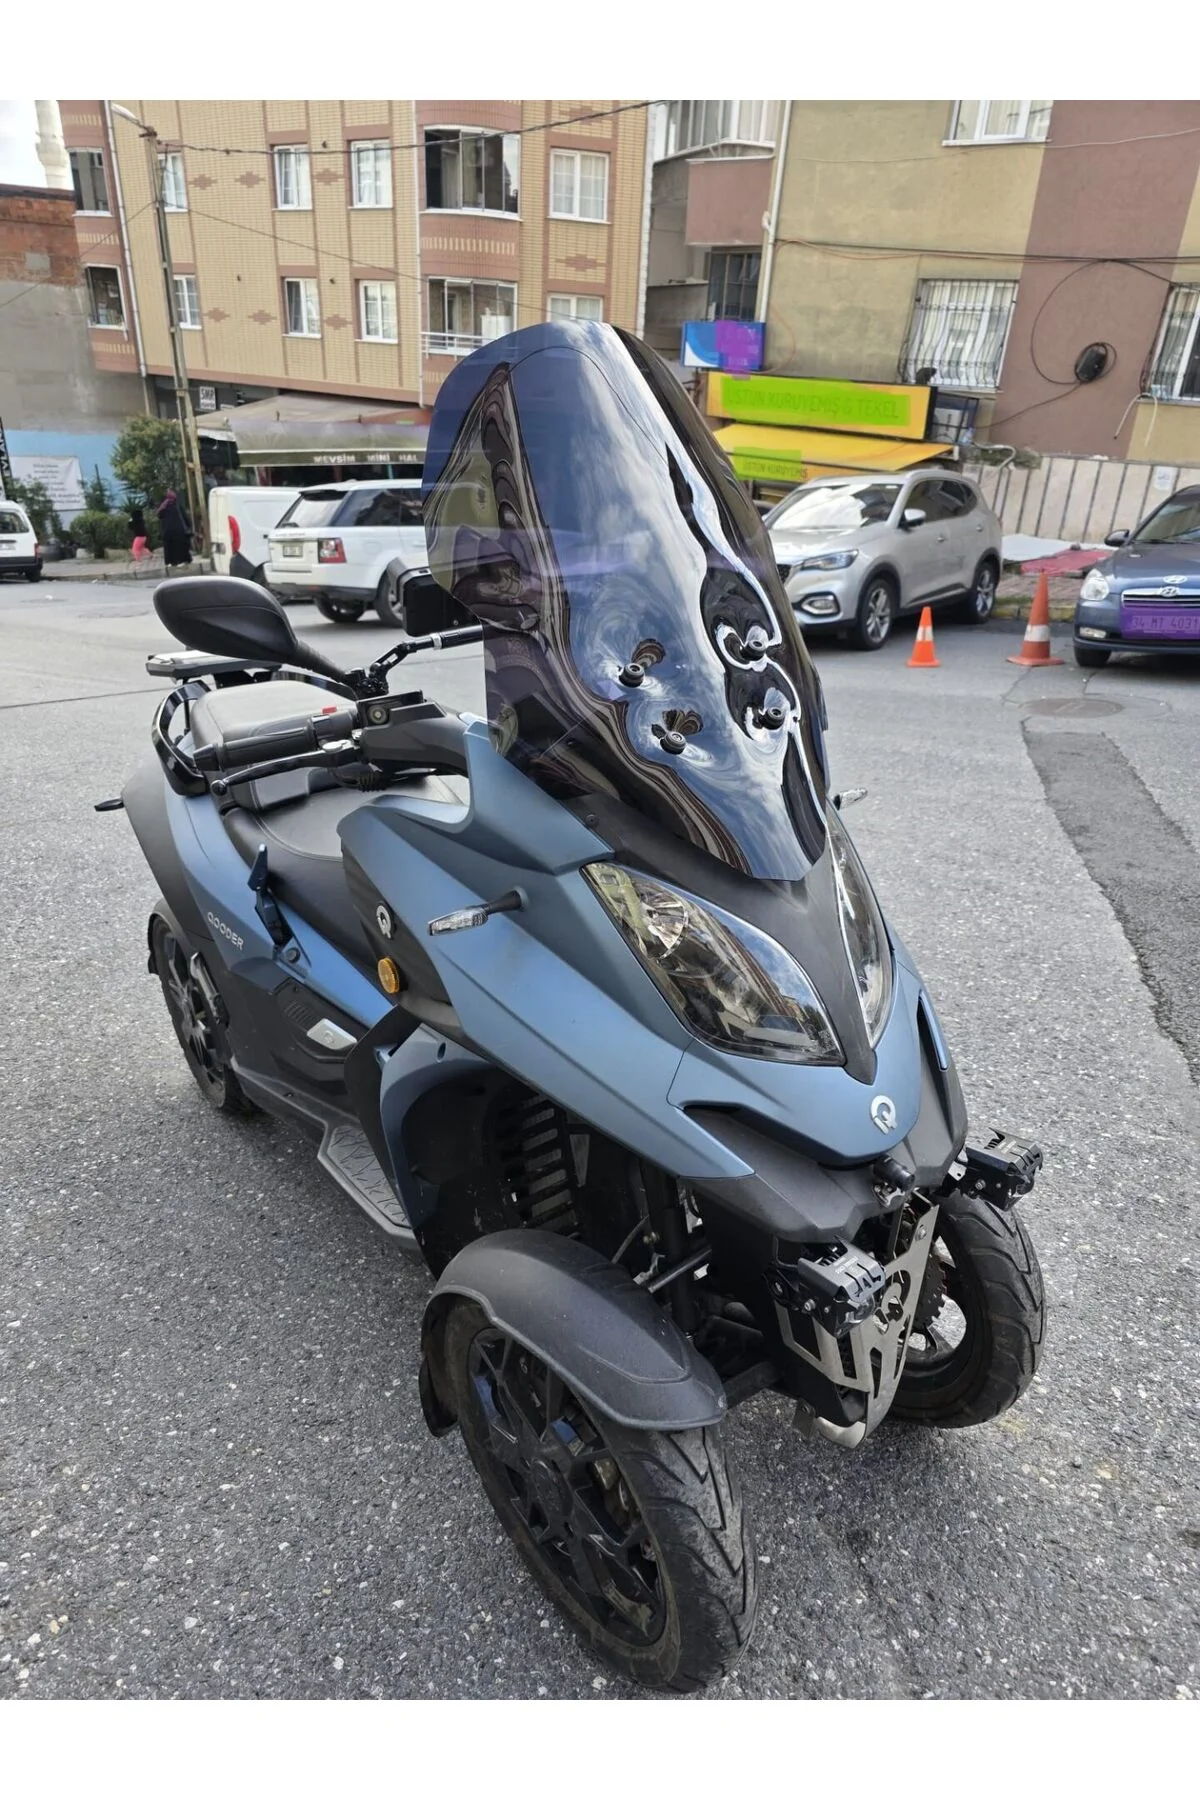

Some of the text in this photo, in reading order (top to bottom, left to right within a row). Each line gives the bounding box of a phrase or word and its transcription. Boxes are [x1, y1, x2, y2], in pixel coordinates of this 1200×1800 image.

[858, 399, 899, 419] TEKEL
[1134, 617, 1145, 628] 34
[207, 911, 244, 950] QOODER
